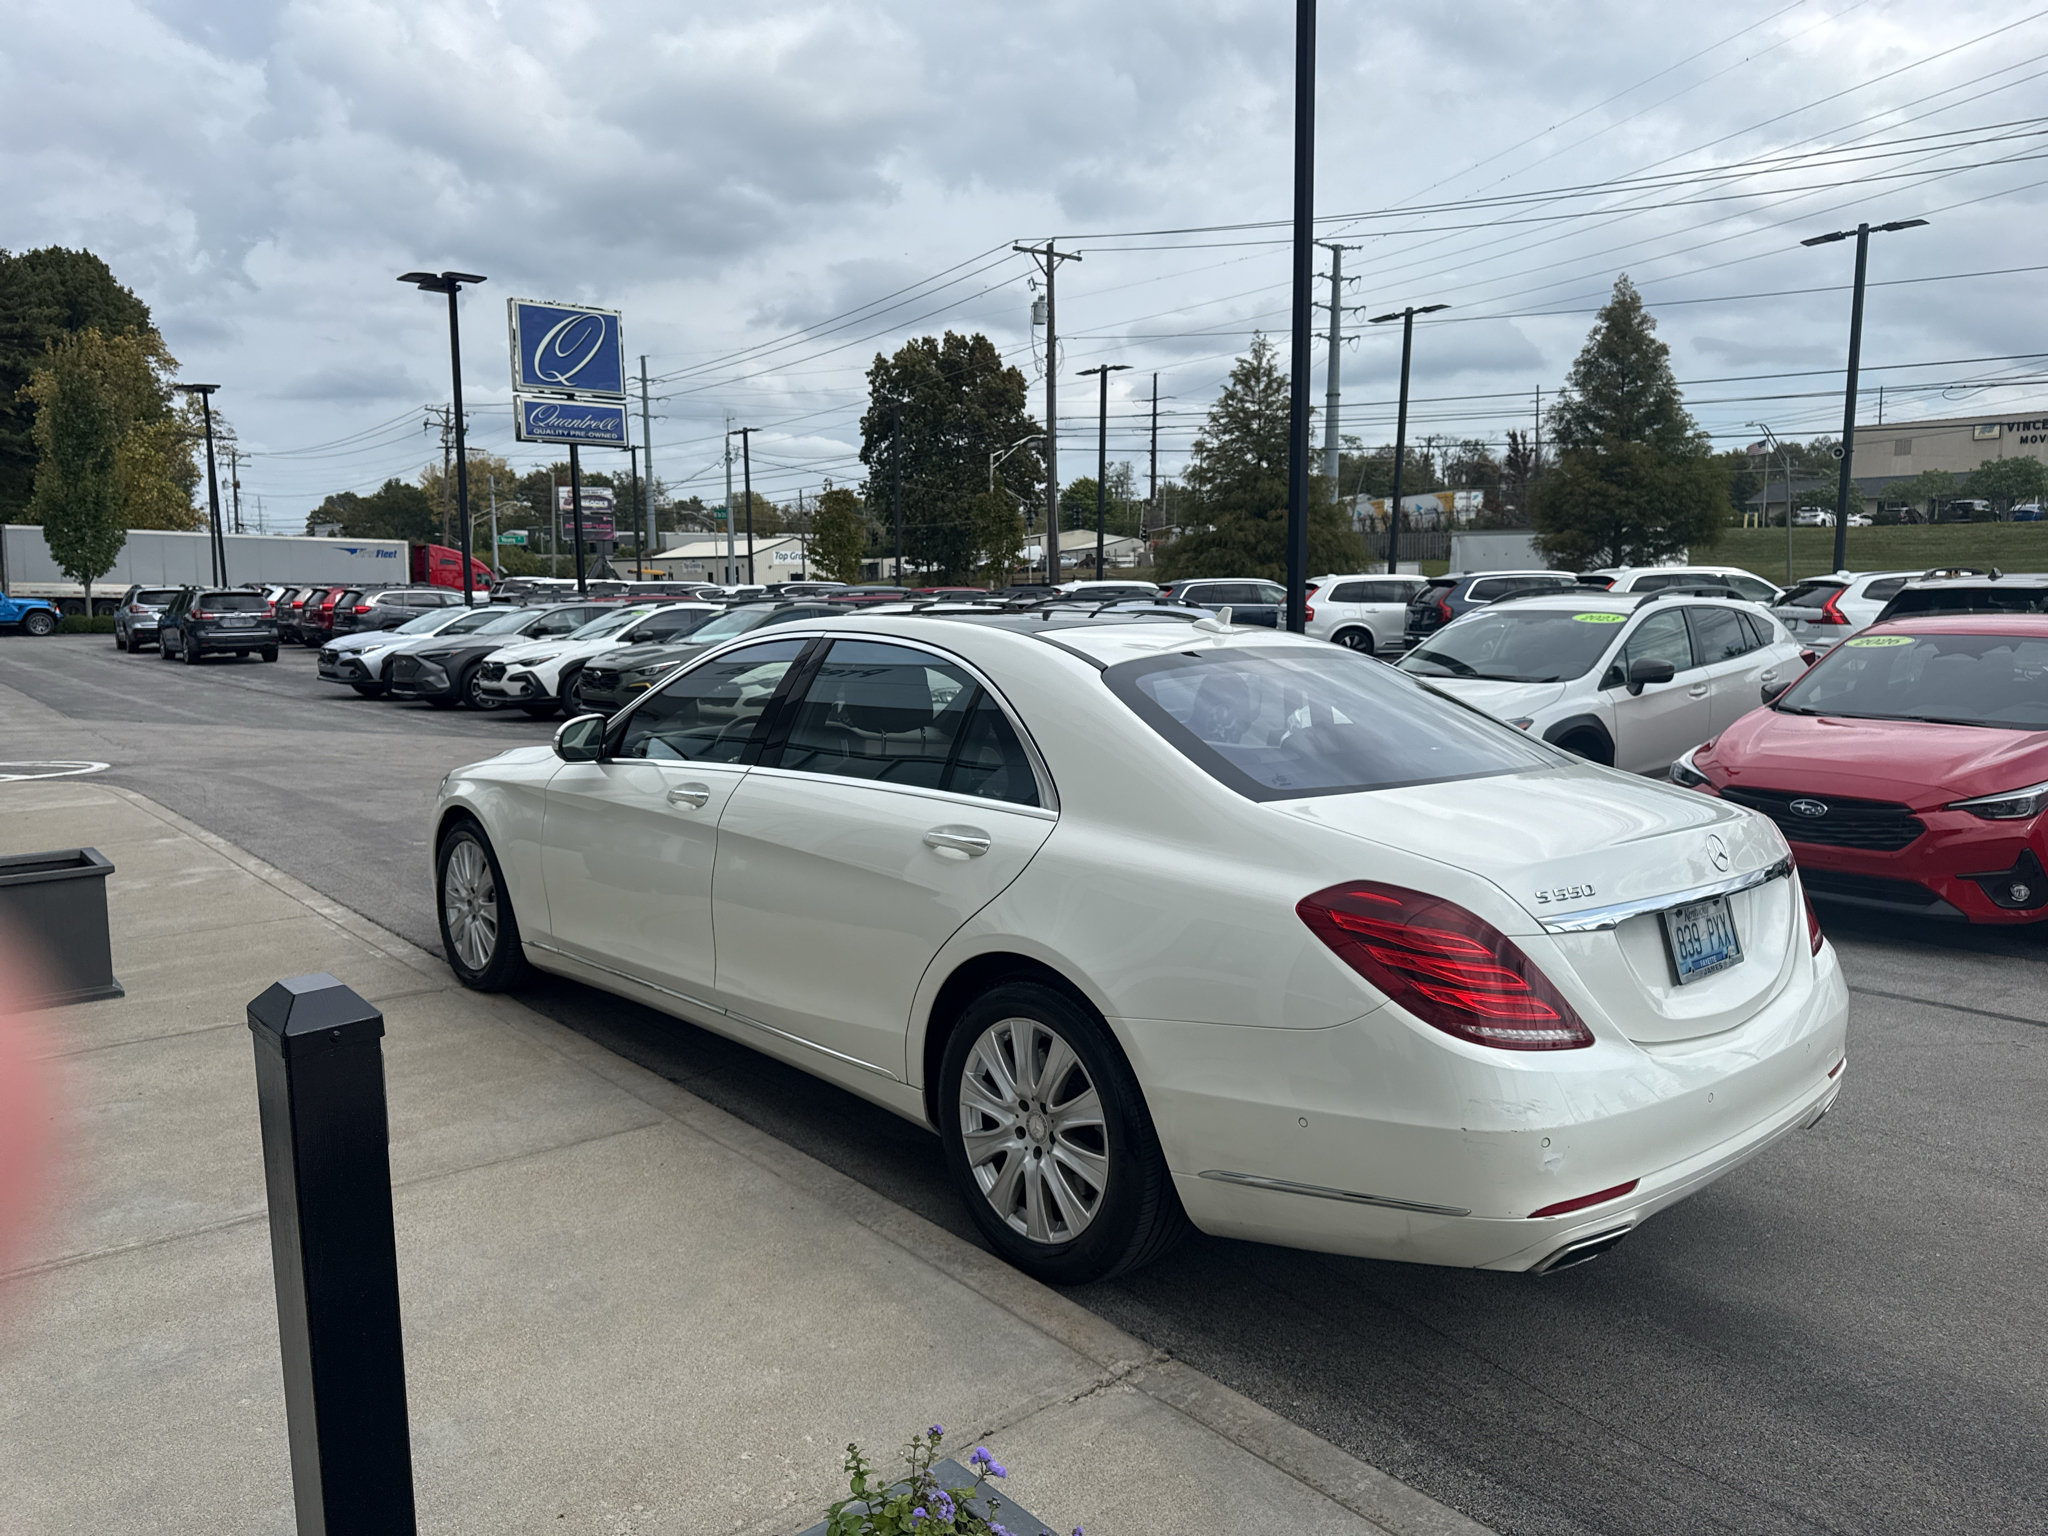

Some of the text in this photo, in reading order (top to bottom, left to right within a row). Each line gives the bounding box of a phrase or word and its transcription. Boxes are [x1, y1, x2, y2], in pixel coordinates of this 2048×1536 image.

[534, 313, 605, 387] Q
[529, 404, 619, 431] Quantrell
[533, 428, 618, 439] QUALITY PRE-OWNED
[375, 549, 398, 559] Fleet
[775, 551, 789, 561] Top
[1535, 884, 1596, 904] S 550
[1676, 912, 1732, 960] 839 PXX
